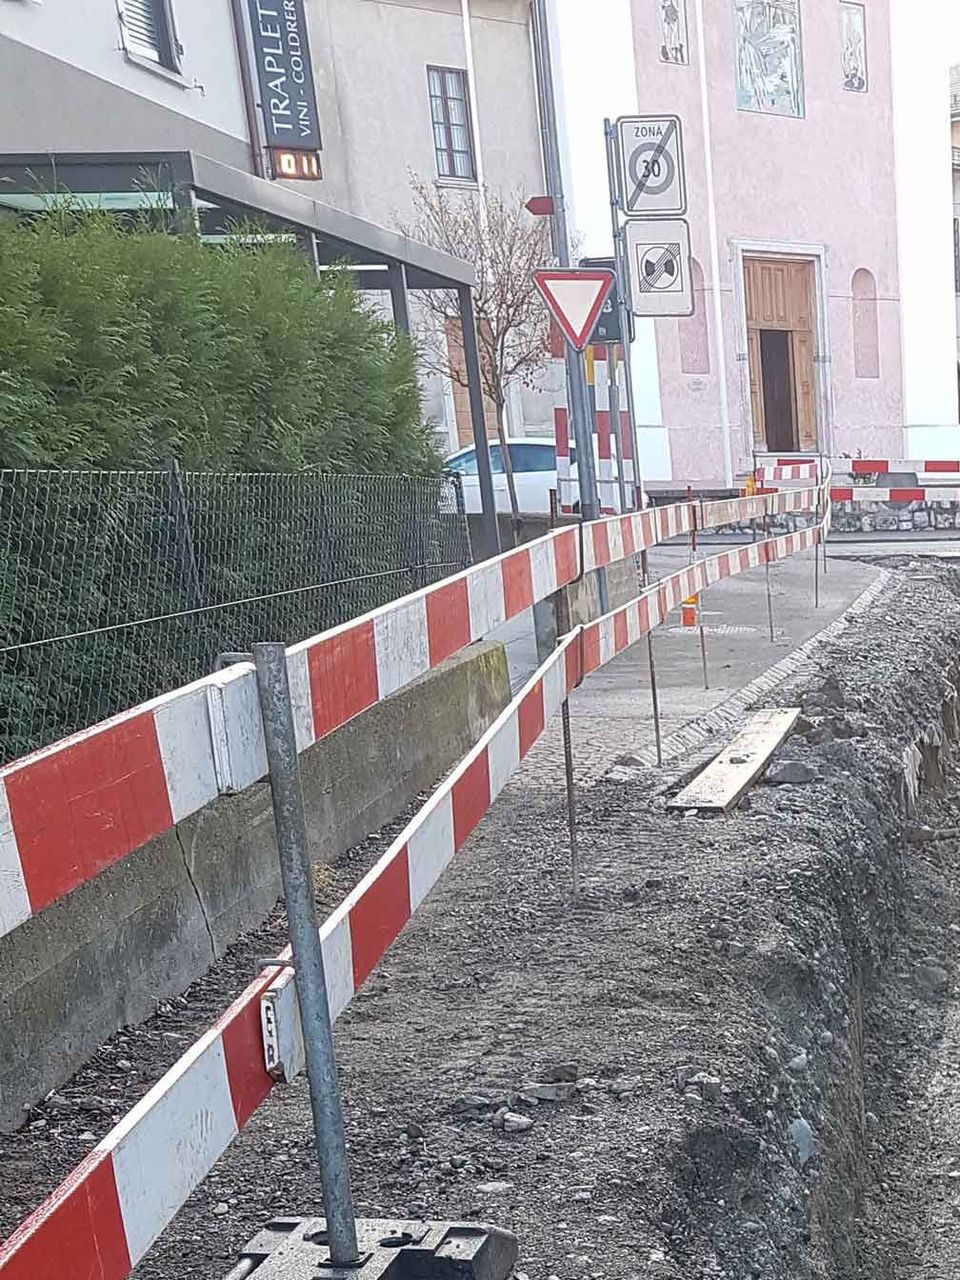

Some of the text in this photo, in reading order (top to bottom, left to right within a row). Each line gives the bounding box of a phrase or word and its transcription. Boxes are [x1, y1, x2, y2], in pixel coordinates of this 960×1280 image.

[295, 101, 312, 137] VINI
[633, 126, 663, 138] ZONA
[641, 159, 661, 178] 30
